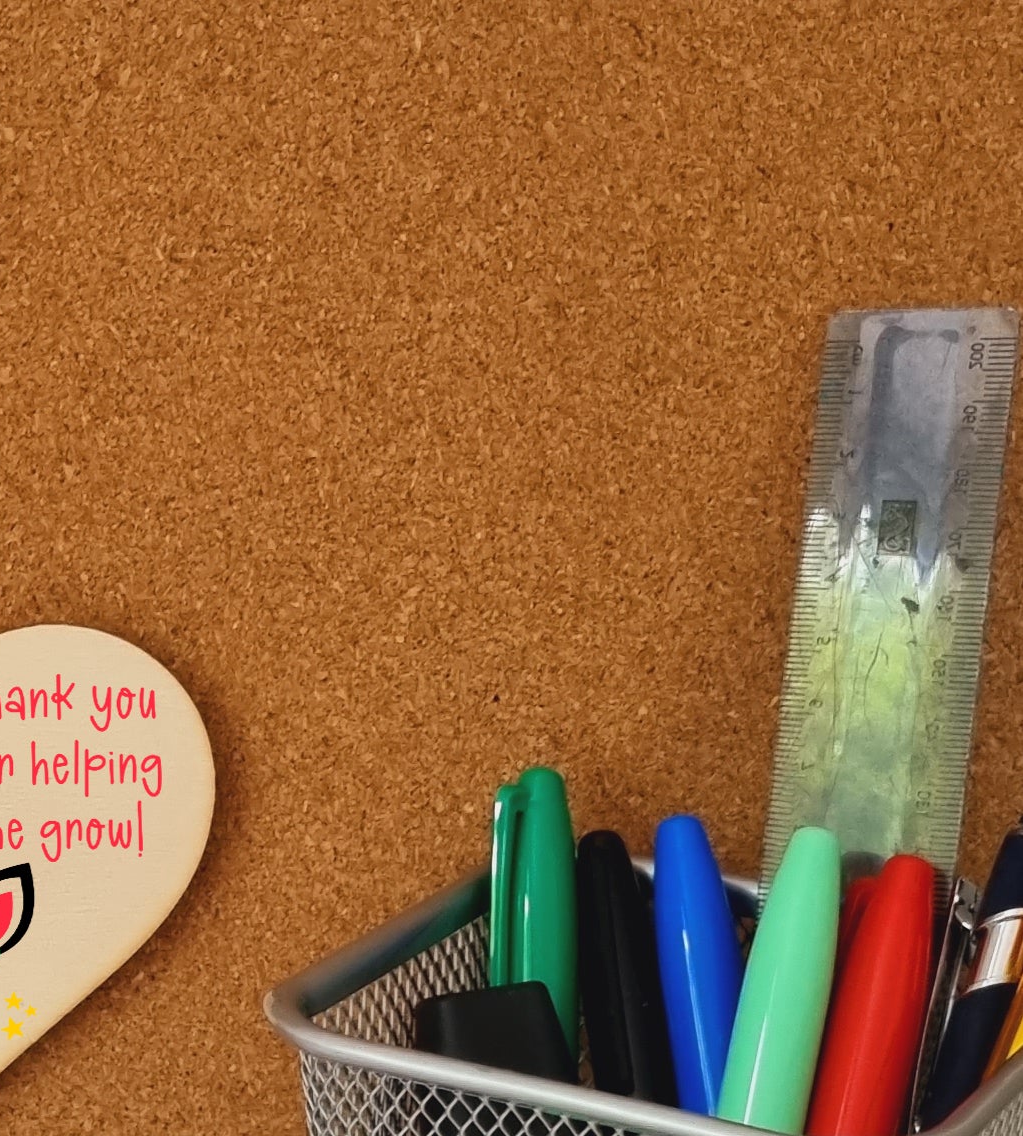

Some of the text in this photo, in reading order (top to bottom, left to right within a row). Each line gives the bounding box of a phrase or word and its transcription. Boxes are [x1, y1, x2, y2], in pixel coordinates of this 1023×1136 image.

[90, 686, 156, 732] you
[31, 740, 163, 797] helping
[40, 801, 145, 863] grow!
